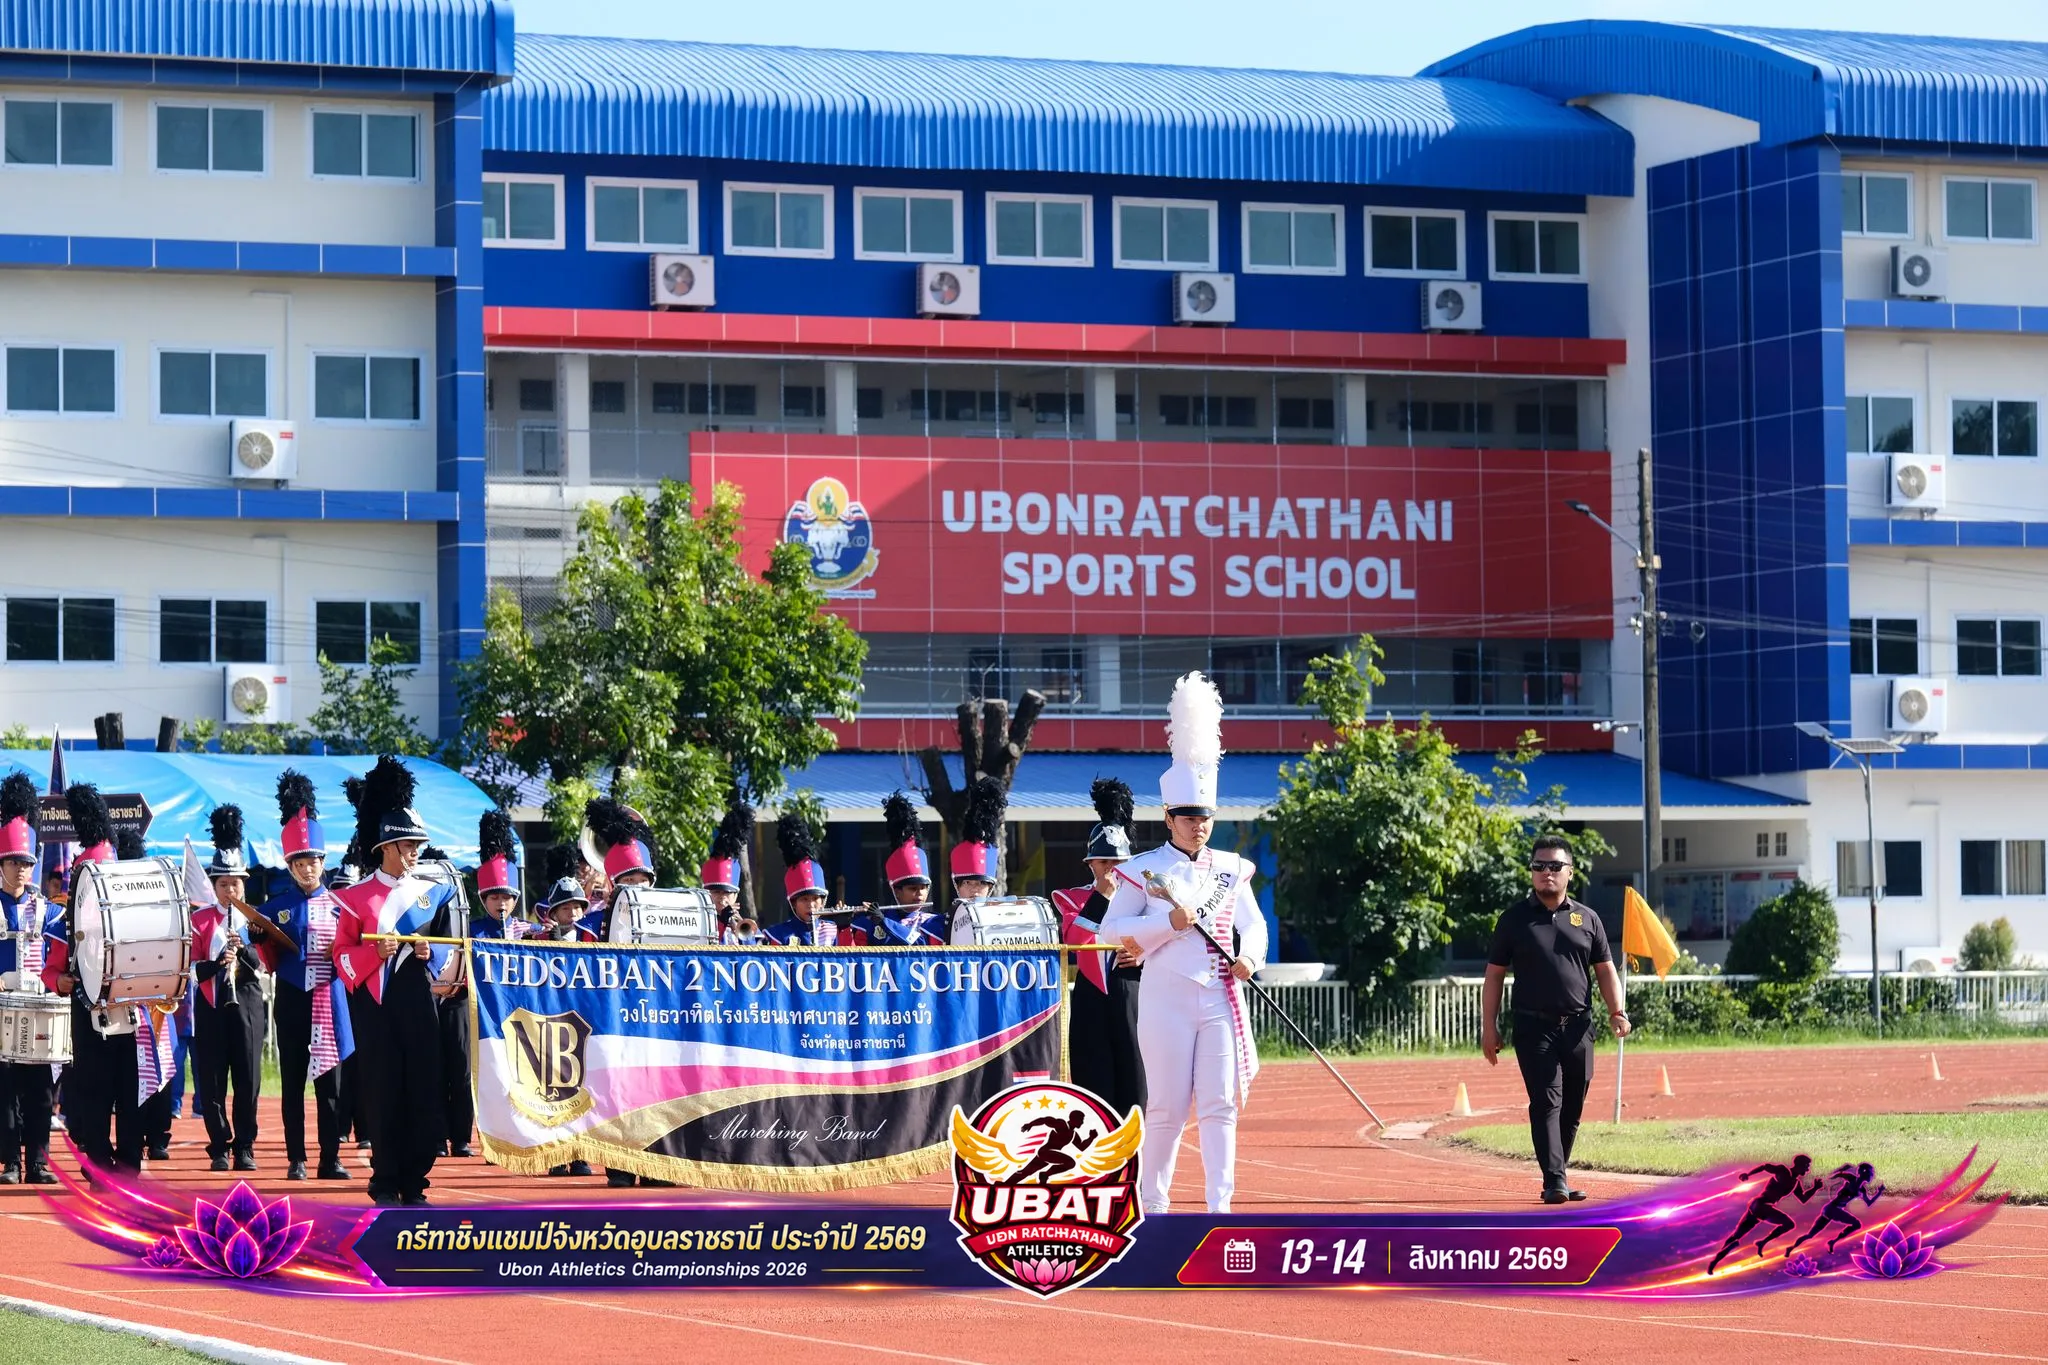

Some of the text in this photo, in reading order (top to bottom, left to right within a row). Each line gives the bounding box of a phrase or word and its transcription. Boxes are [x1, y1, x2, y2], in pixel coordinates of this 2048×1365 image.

[942, 490, 1454, 542] UBONRATCHATHANI
[1002, 551, 1417, 600] SPORTS SCHOOL
[124, 880, 165, 892] YAMAHA
[658, 915, 698, 927] YAMAHA
[1196, 907, 1207, 919] 2
[1003, 935, 1041, 945] YAMAHA
[476, 950, 1058, 993] TEDSABAN 2 NONGBUA SCHOOL
[866, 1002, 932, 1026] หนองบัว
[20, 1025, 29, 1054] YAMAHA
[799, 1032, 906, 1055] จังหวัดอุบลราชธานี
[509, 1020, 580, 1090] NB
[559, 1099, 581, 1111] BAND
[708, 1113, 887, 1151] Marching Band
